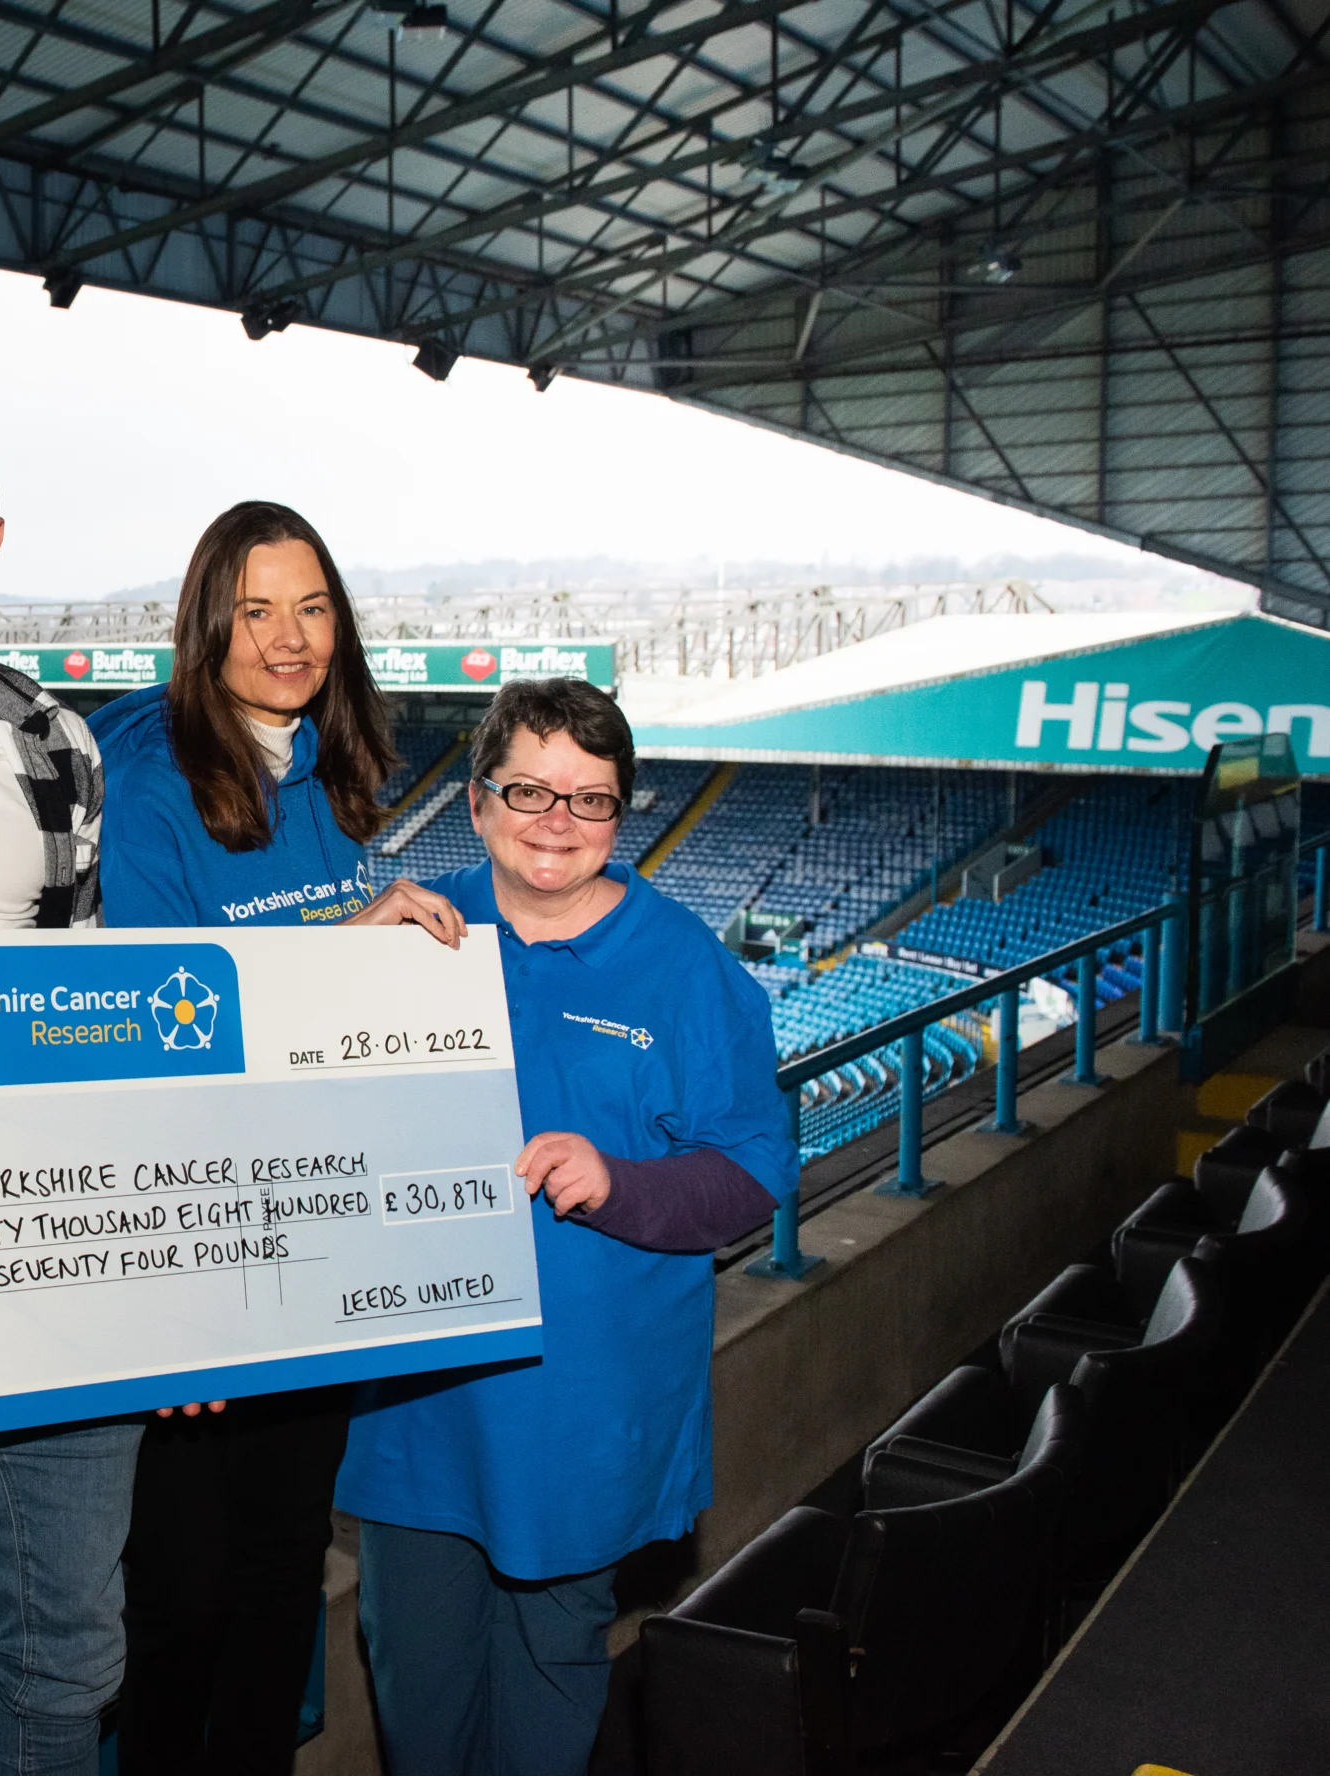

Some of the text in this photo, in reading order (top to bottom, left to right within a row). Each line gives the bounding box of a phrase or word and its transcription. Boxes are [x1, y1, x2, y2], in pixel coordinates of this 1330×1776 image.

[92, 649, 156, 670] Burflex
[499, 646, 588, 672] Burflex
[222, 890, 305, 922] Yorkshire
[50, 984, 141, 1011] Cancer
[30, 1019, 142, 1047] Research
[563, 1012, 631, 1032] Yorkshire Cancer
[592, 1025, 627, 1039] Research
[289, 1050, 325, 1066] DATE
[134, 1158, 236, 1191] CANCER
[251, 1153, 367, 1183] RESEARCH
[406, 1178, 497, 1215] 30,874
[31, 1207, 166, 1239] THOUSAND
[177, 1200, 253, 1229] EIGHT
[266, 1192, 369, 1222] HUNDRED
[121, 1243, 184, 1272] FOUR
[194, 1234, 289, 1264] POUNDS
[343, 1274, 494, 1316] LEEDS UNITED
